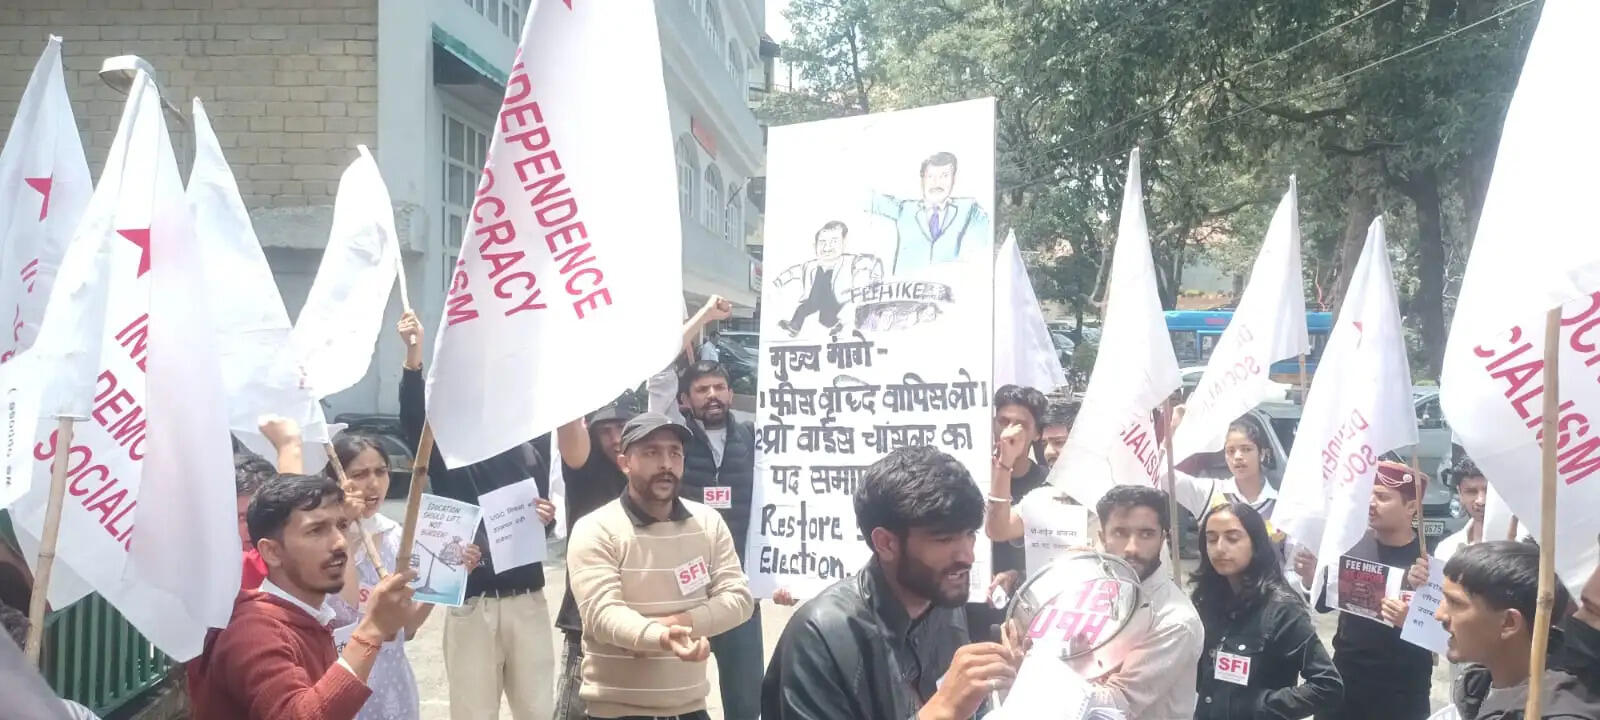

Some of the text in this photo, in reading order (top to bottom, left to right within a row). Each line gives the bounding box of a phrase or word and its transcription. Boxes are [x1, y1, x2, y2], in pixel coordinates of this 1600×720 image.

[500, 48, 612, 319] DEPENDENCE
[473, 152, 547, 316] OCRACY
[769, 345, 822, 381] मुख्य
[770, 465, 802, 494] पद
[705, 490, 730, 502] SFI
[760, 501, 843, 541] Restore
[679, 561, 707, 585] SFI
[1346, 560, 1384, 575] FEE HIKE
[1218, 657, 1248, 675] SFI
